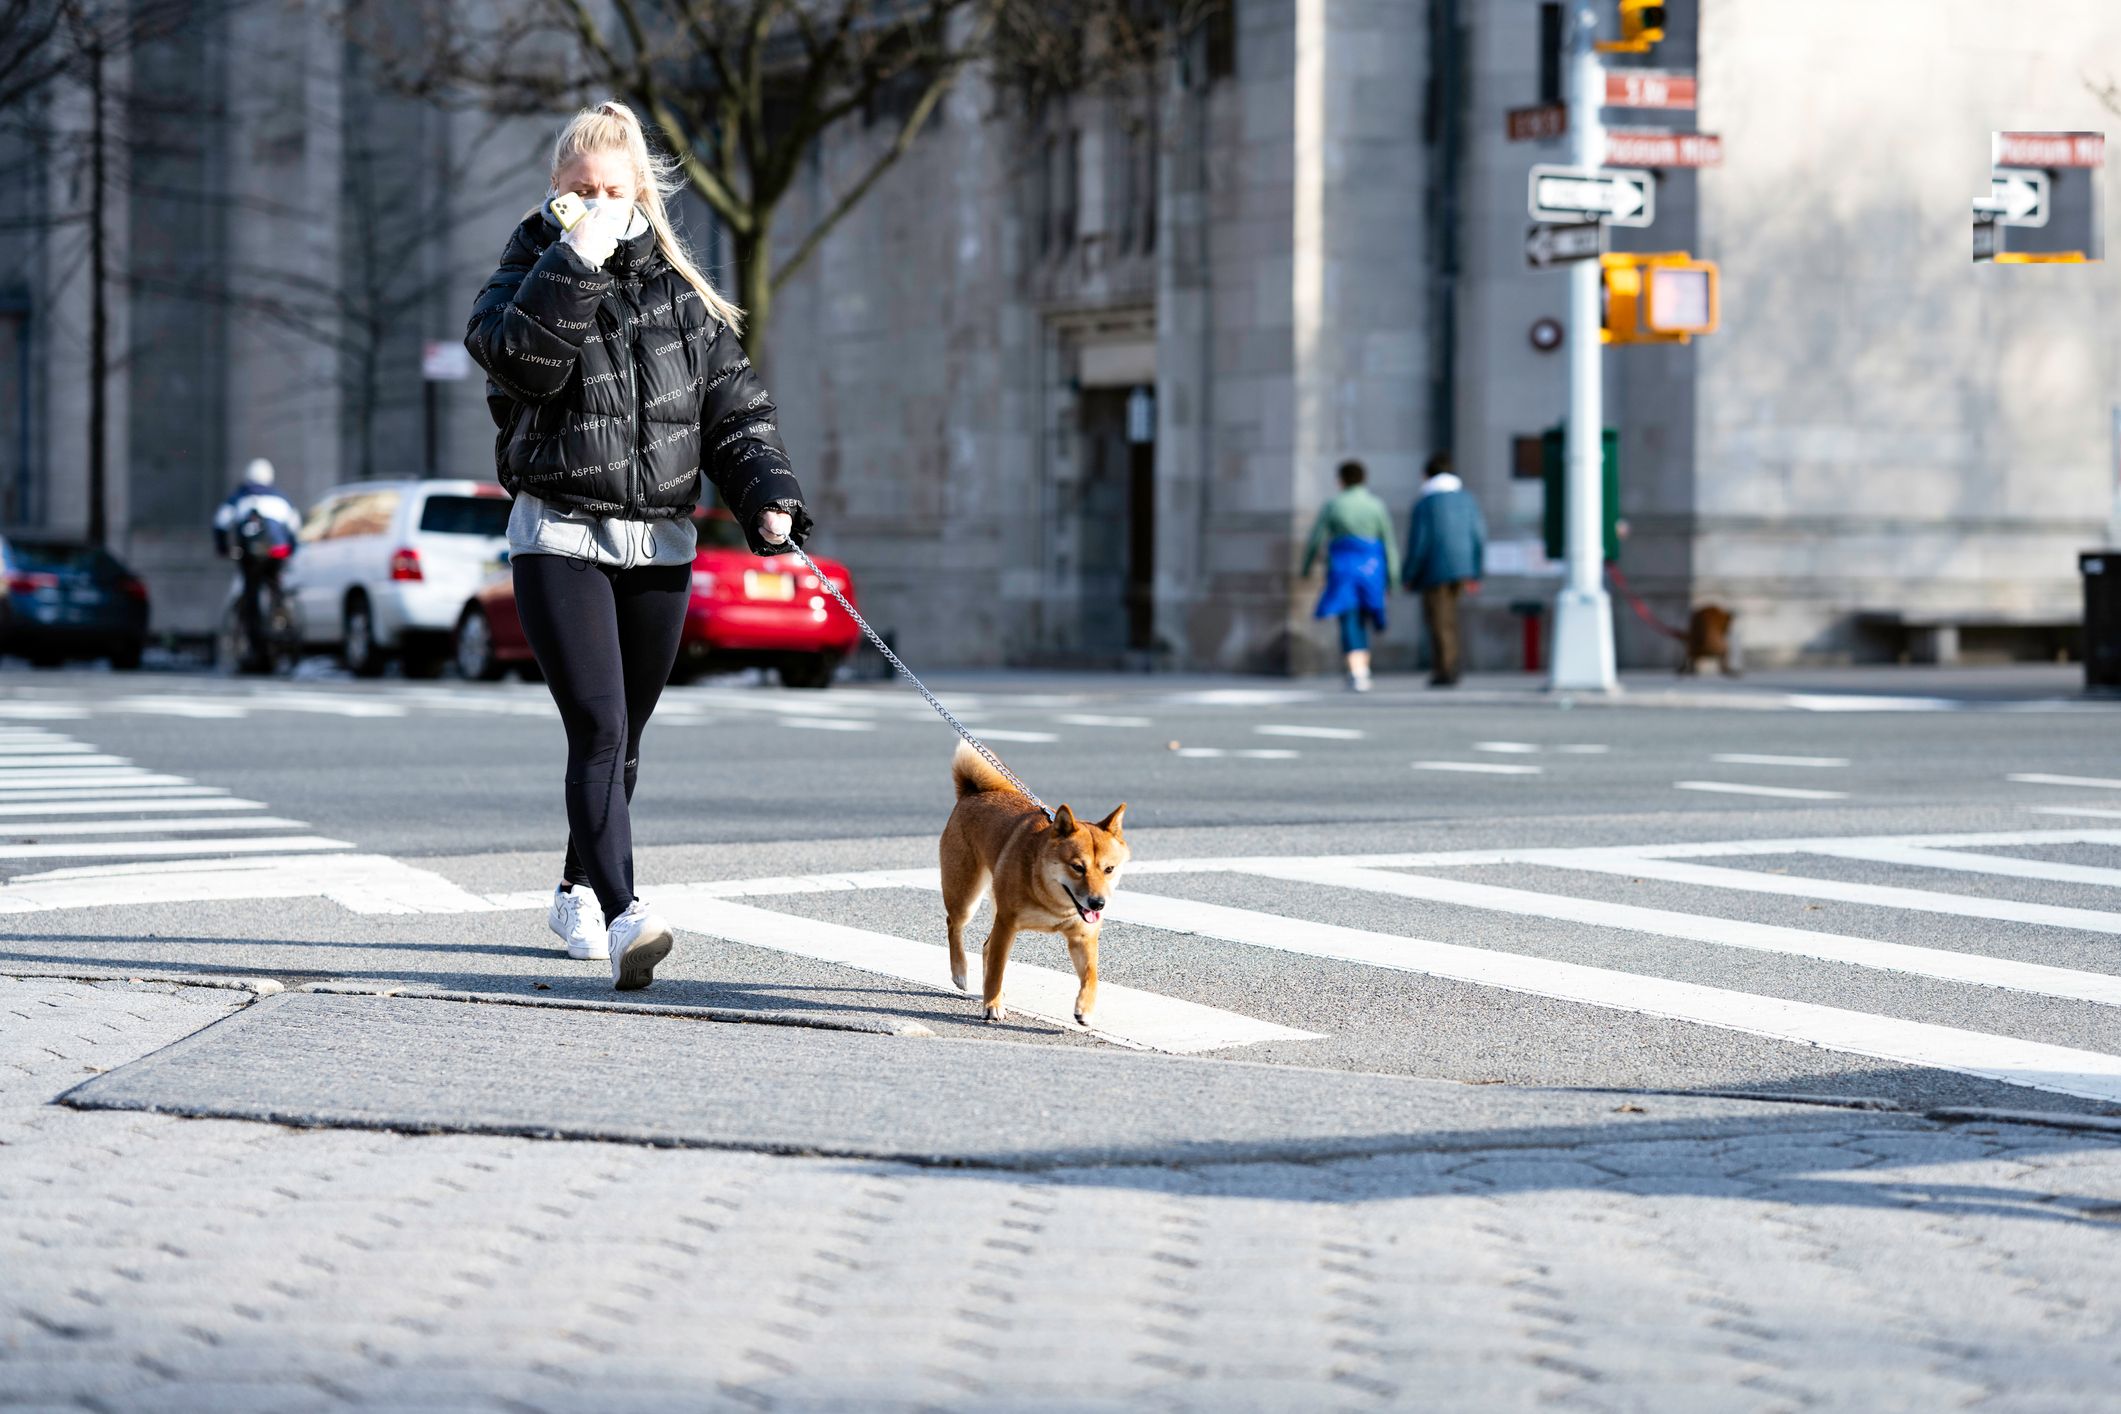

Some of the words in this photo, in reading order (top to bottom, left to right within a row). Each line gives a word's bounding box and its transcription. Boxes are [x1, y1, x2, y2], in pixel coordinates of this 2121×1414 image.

[538, 270, 572, 285] NISEKO
[652, 302, 673, 316] ASPE
[584, 335, 603, 344] SPE
[519, 352, 562, 368] ZERMATT
[644, 389, 682, 410] AMPEZZO
[574, 419, 607, 433] NISEKO
[667, 427, 689, 444] ASPEN
[570, 465, 602, 478] ASPEN
